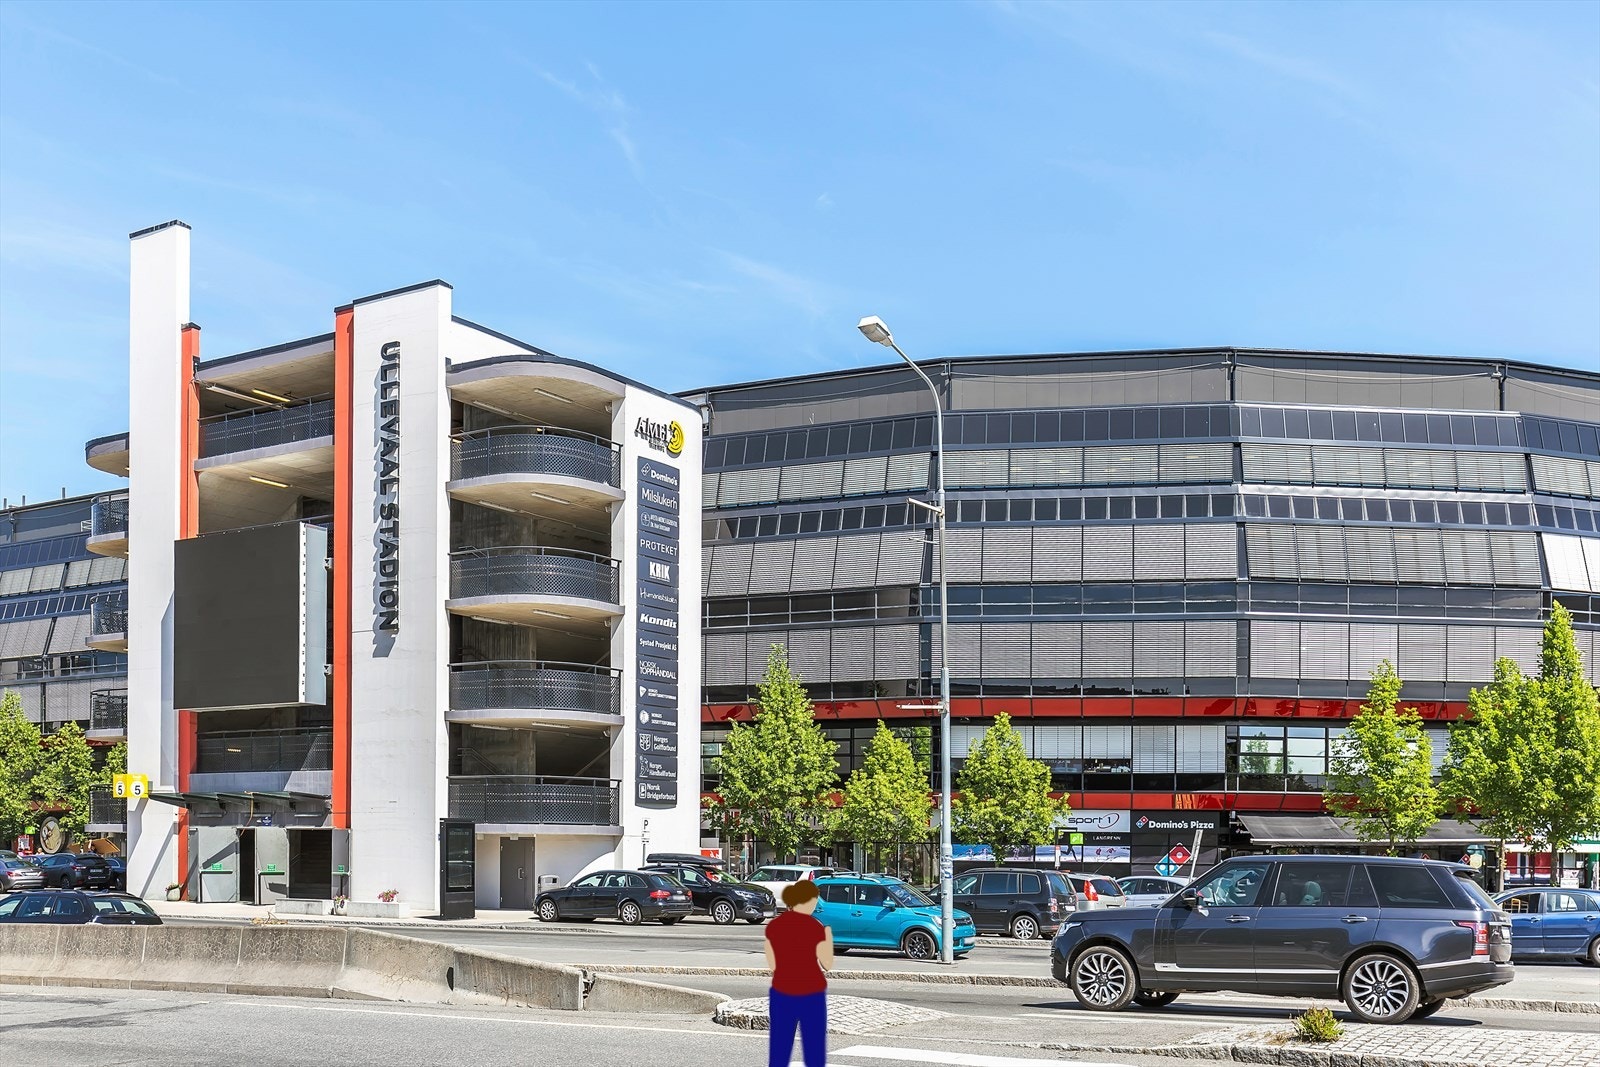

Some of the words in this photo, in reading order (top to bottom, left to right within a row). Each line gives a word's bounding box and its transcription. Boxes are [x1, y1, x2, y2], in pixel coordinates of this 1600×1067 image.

[379, 340, 401, 496] ULLEVAAL
[379, 502, 400, 631] STADION
[649, 561, 670, 580] KRIK
[640, 612, 677, 629] Kondis
[117, 784, 123, 796] 5
[134, 784, 141, 796] 5
[643, 819, 649, 830] P
[1068, 816, 1103, 825] sport
[1148, 820, 1189, 829] Domino's
[1190, 820, 1215, 829] Pizza
